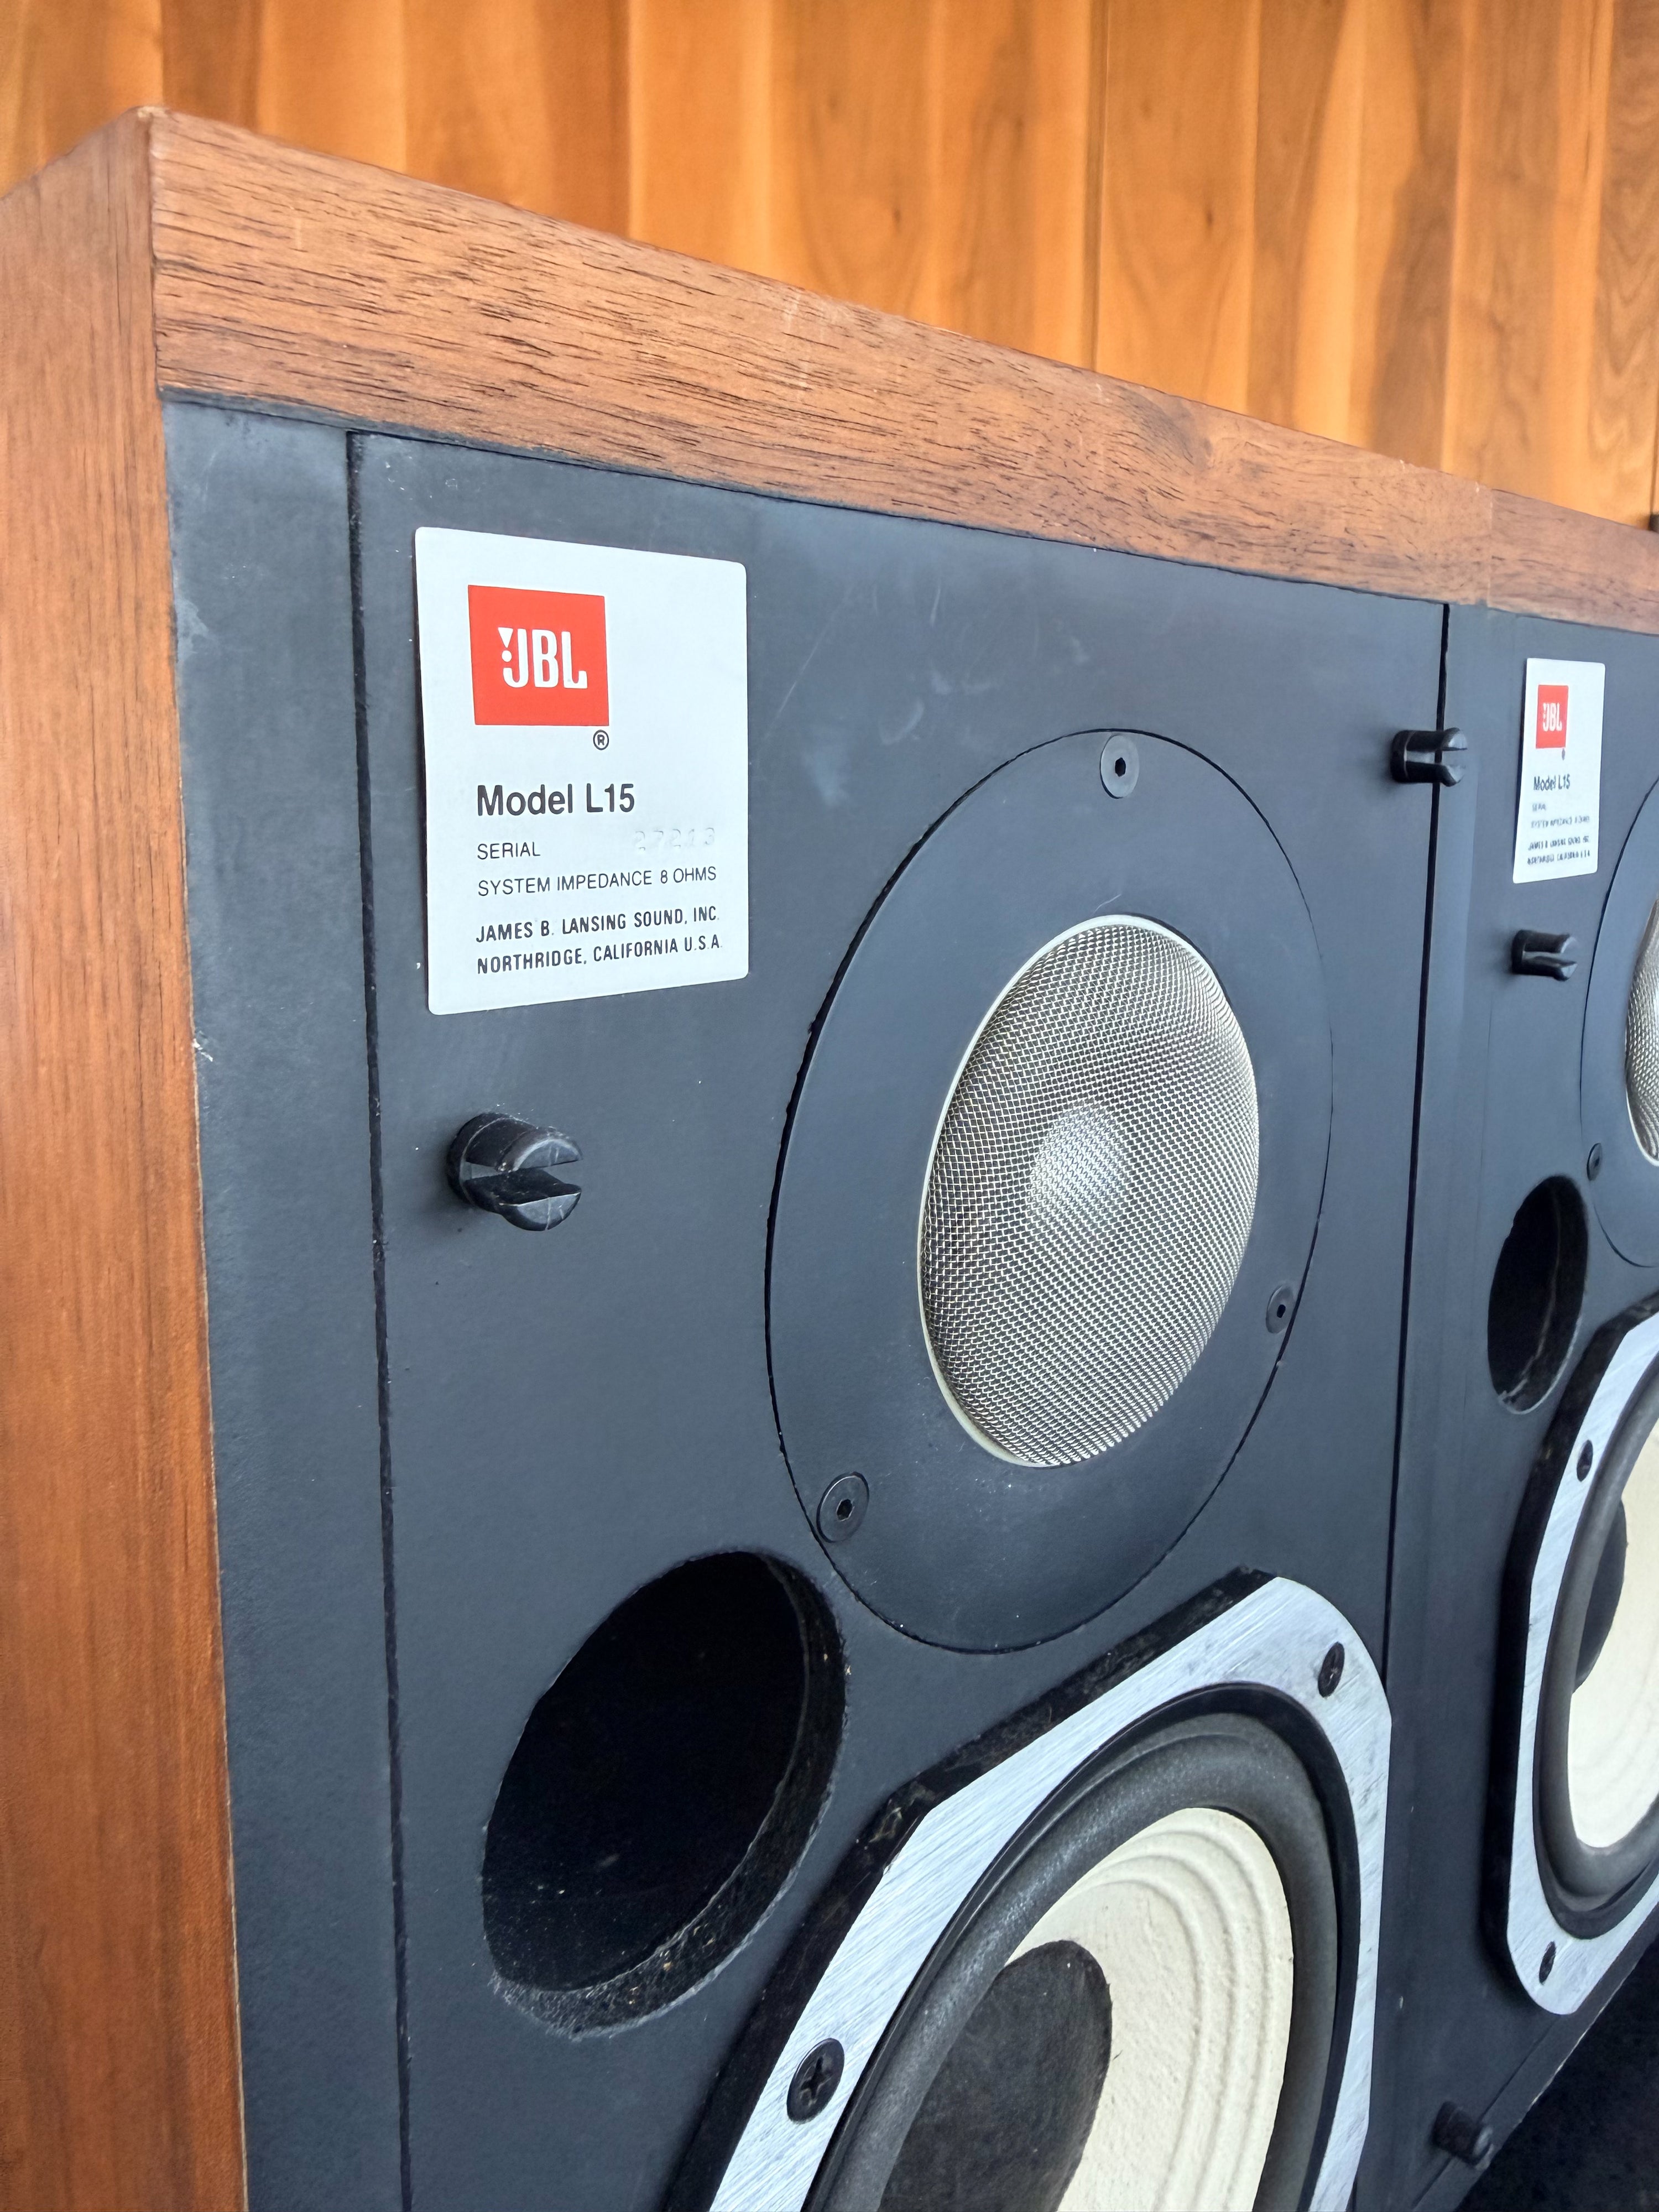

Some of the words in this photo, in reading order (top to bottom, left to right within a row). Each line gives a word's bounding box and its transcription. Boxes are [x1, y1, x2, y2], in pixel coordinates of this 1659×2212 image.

[498, 627, 588, 689] JBL
[1542, 702, 1562, 732] JBL
[1533, 775, 1556, 791] Model
[1558, 773, 1571, 790] L15
[477, 783, 572, 816] Model
[586, 782, 635, 813] L15
[477, 842, 541, 860] SERIAL
[478, 877, 550, 896] SYSTEM
[557, 870, 652, 891] IMPEDANCE
[660, 869, 668, 884] 8
[673, 866, 717, 884] OHMS
[476, 922, 533, 943] JAMES
[541, 920, 555, 936] B.
[562, 914, 626, 935] LANSING
[634, 908, 687, 928] SOUND,
[477, 948, 587, 974] NORTHRIDGE,
[593, 938, 679, 963] CALIFORNIA
